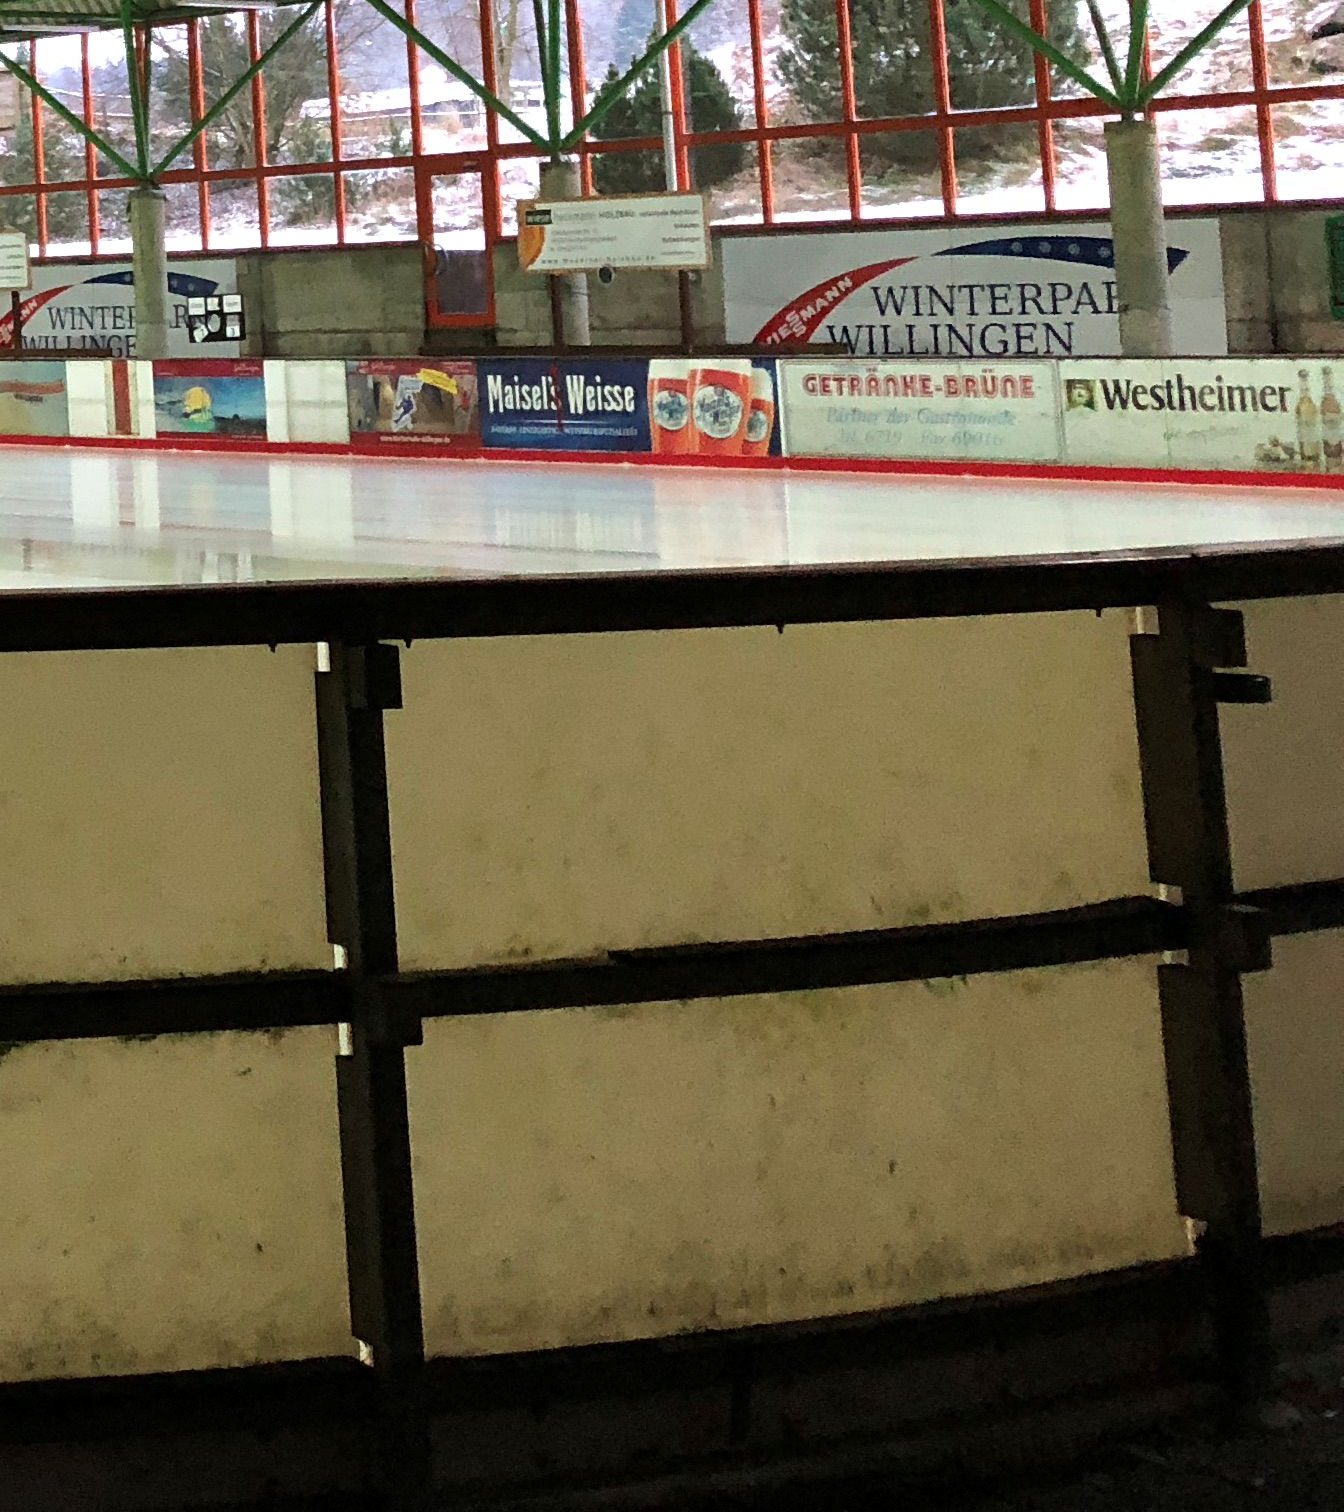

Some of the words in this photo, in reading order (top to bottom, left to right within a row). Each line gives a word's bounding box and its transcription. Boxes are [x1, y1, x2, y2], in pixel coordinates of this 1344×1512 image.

[872, 281, 1120, 317] WINTERPA
[565, 375, 636, 414] Weisse
[802, 367, 1035, 399] GETRÄNKE-BRÜNE
[1099, 373, 1294, 413] Westheimer
